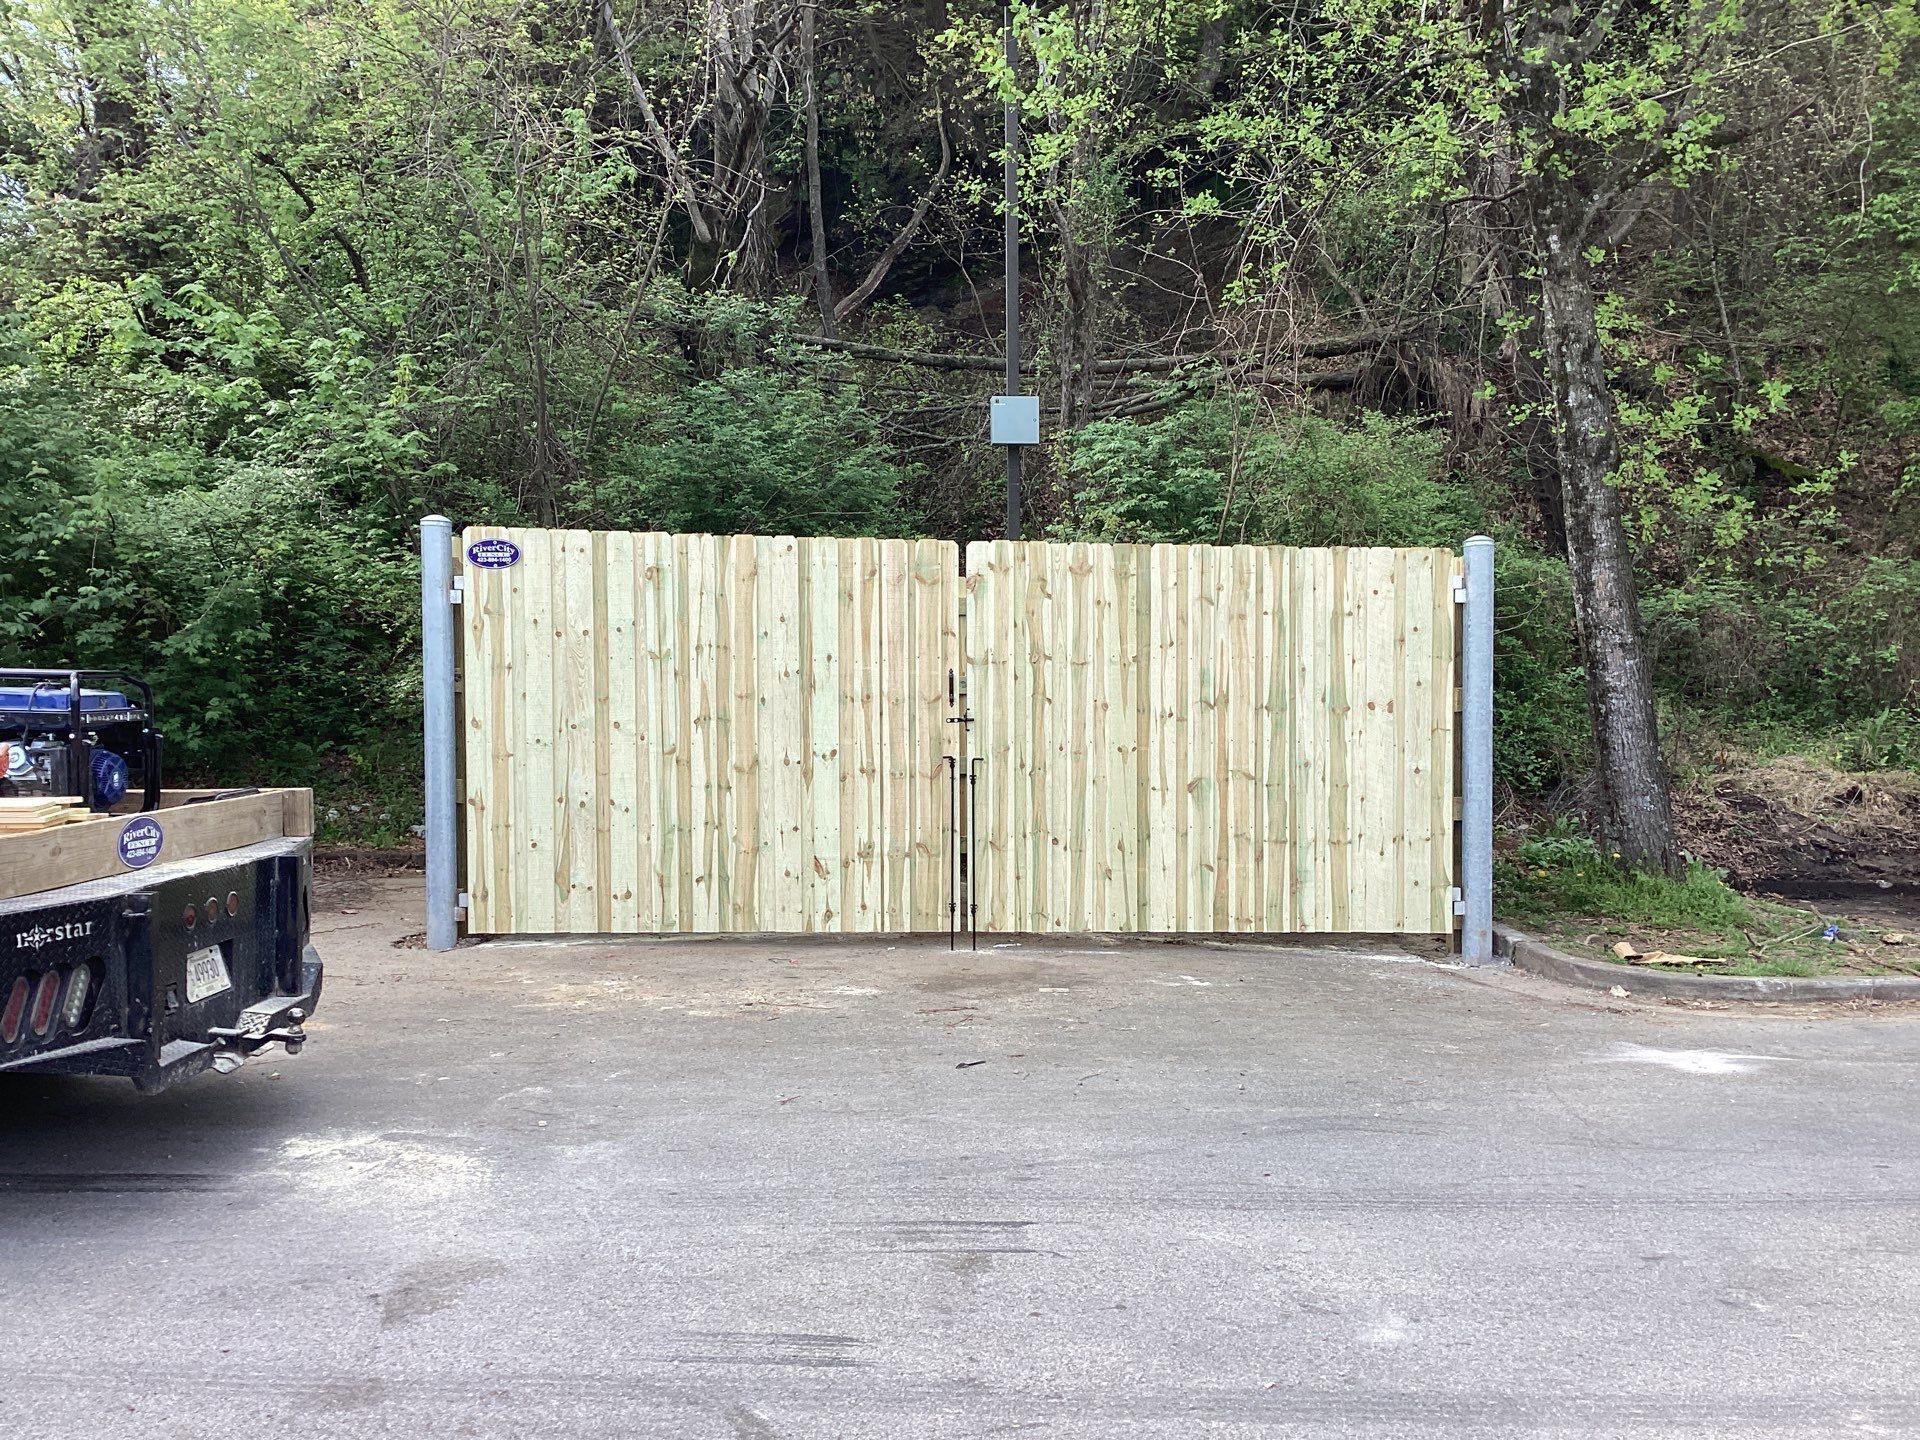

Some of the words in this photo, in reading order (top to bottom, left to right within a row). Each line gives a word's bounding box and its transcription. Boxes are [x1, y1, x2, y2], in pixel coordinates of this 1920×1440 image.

[472, 544, 515, 555] RiverCity
[123, 826, 160, 845] RiverCity
[194, 958, 220, 983] 49930
